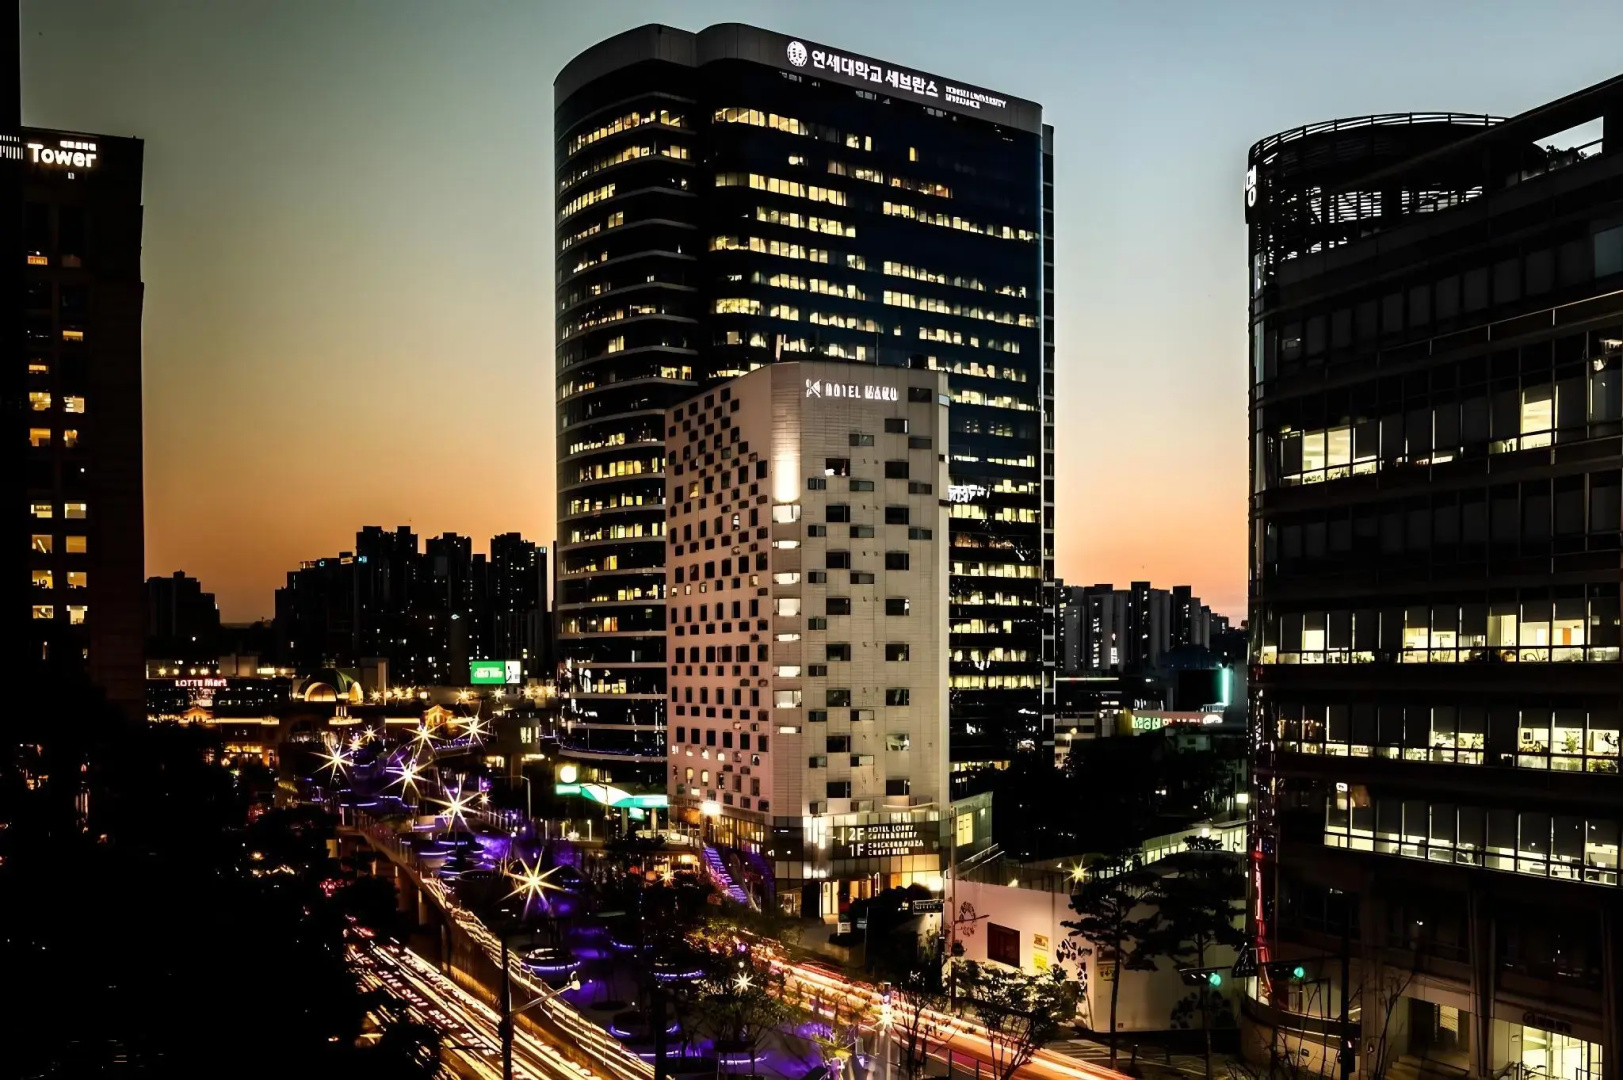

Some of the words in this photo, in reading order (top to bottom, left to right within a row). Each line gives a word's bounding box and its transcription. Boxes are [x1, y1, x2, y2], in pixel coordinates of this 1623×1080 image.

[811, 50, 883, 84] 연세대학교
[885, 69, 939, 98] 세브란스
[27, 142, 97, 168] Tower
[825, 382, 862, 399] HOTEL
[175, 679, 204, 687] LOTTE
[204, 678, 228, 687] Mart
[848, 827, 865, 841] 2F
[848, 843, 865, 857] 1F
